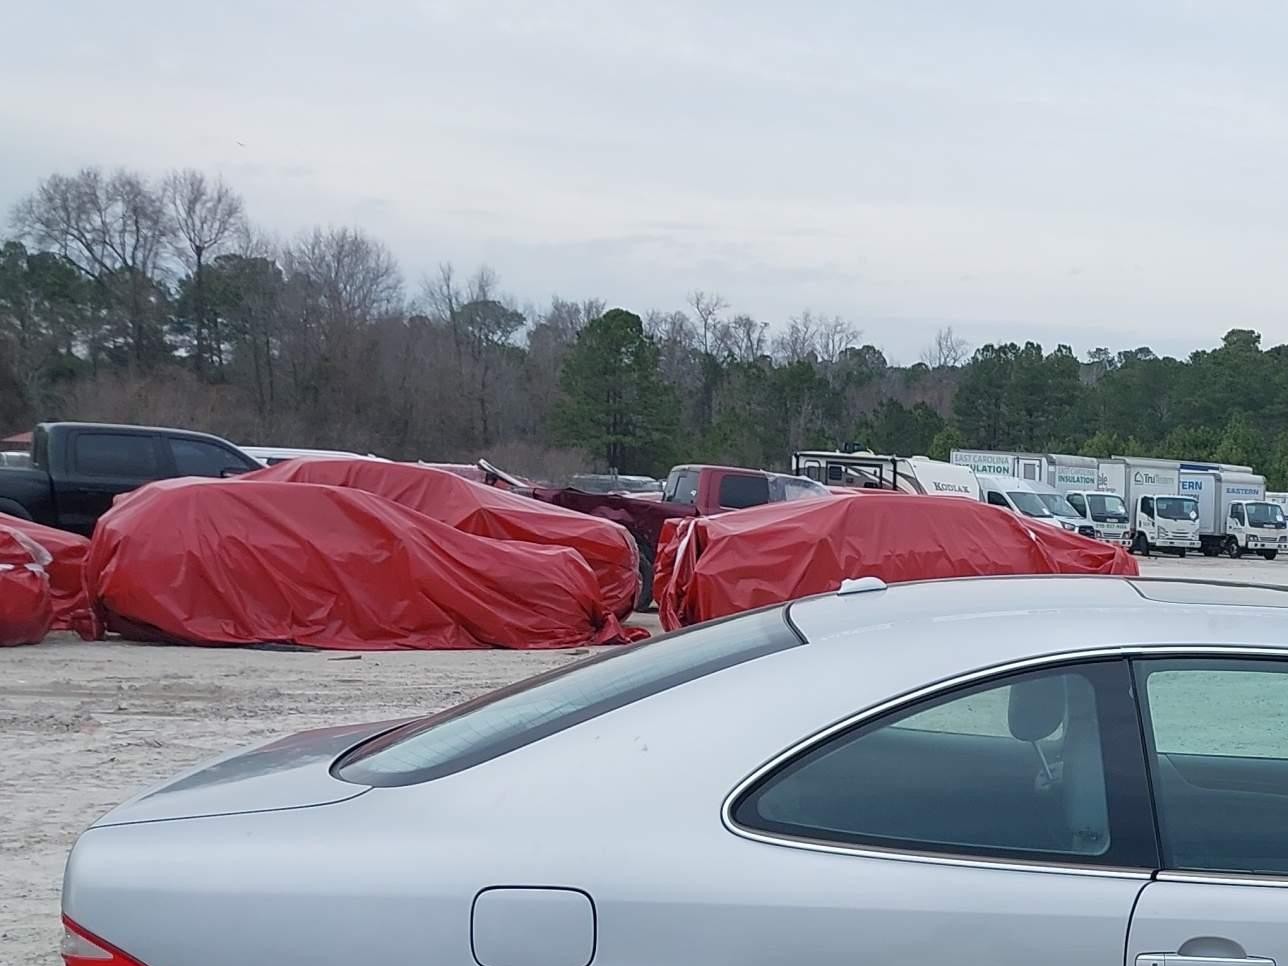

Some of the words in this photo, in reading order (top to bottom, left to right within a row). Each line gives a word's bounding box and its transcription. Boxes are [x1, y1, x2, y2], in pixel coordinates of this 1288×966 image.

[957, 463, 1009, 473] ULATION
[1058, 475, 1095, 484] INSULATION
[932, 481, 970, 493] KODIAK
[1180, 480, 1202, 490] ERN
[1226, 487, 1259, 495] EASTERN
